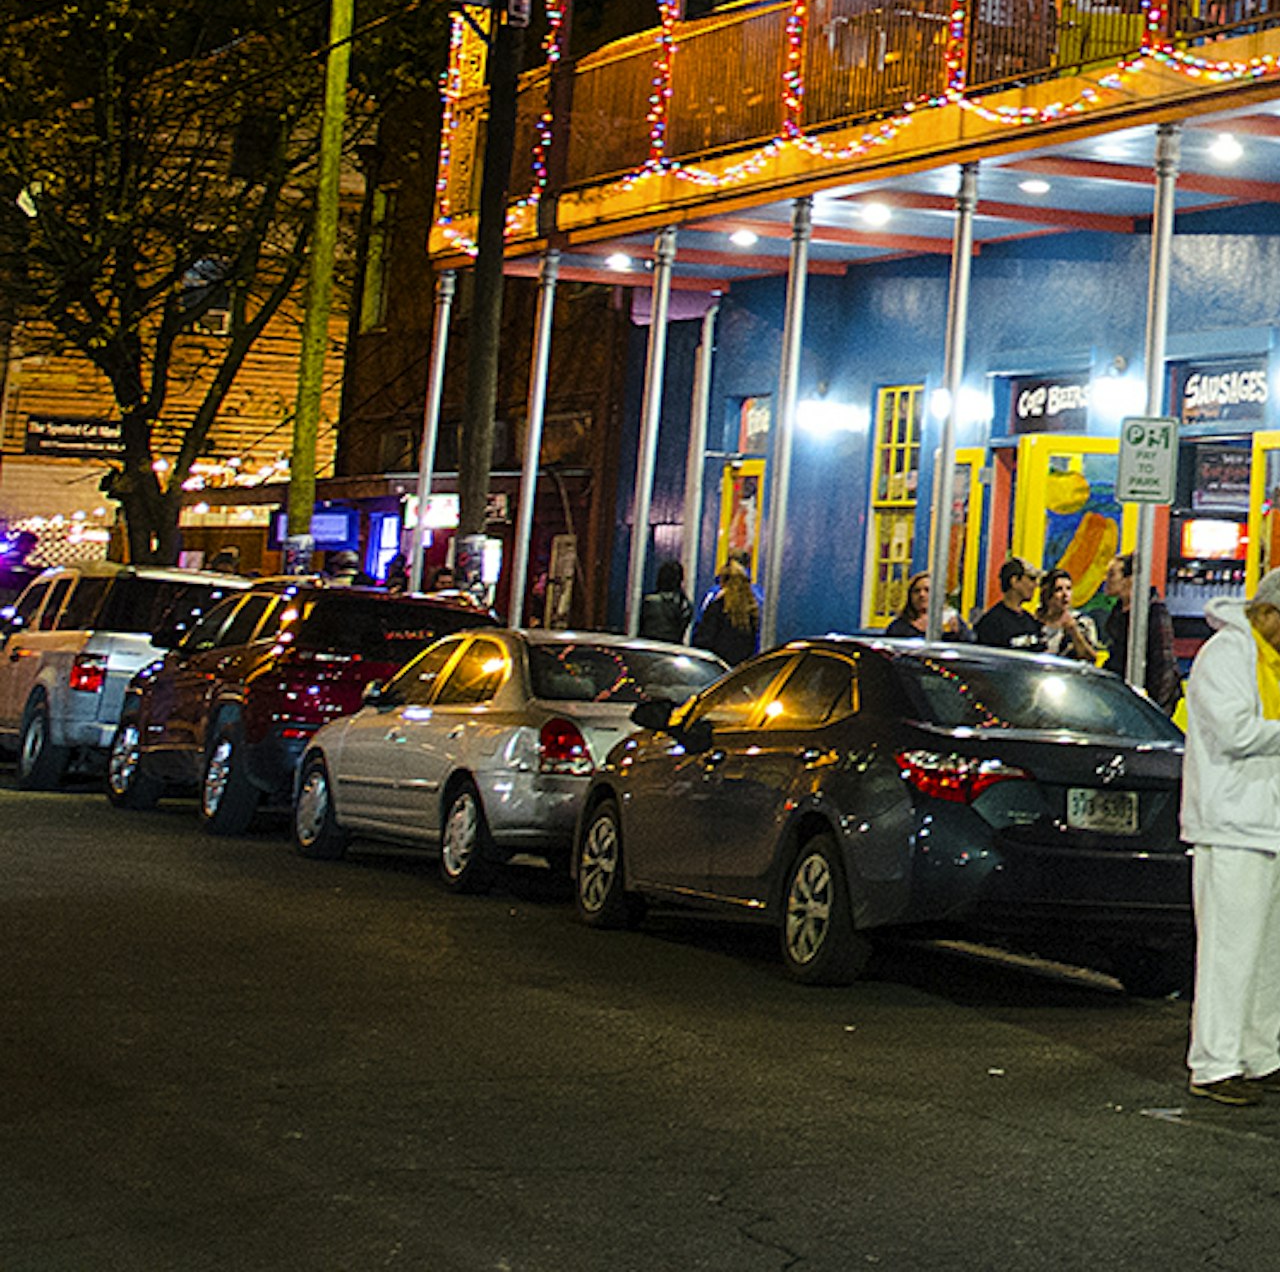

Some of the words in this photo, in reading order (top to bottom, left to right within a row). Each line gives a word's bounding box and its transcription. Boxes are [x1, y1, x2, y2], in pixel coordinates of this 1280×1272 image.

[1184, 371, 1267, 408] SAUSAGES
[1136, 451, 1157, 460] PAY
[1138, 463, 1154, 473] TO
[1128, 476, 1160, 487] PARK
